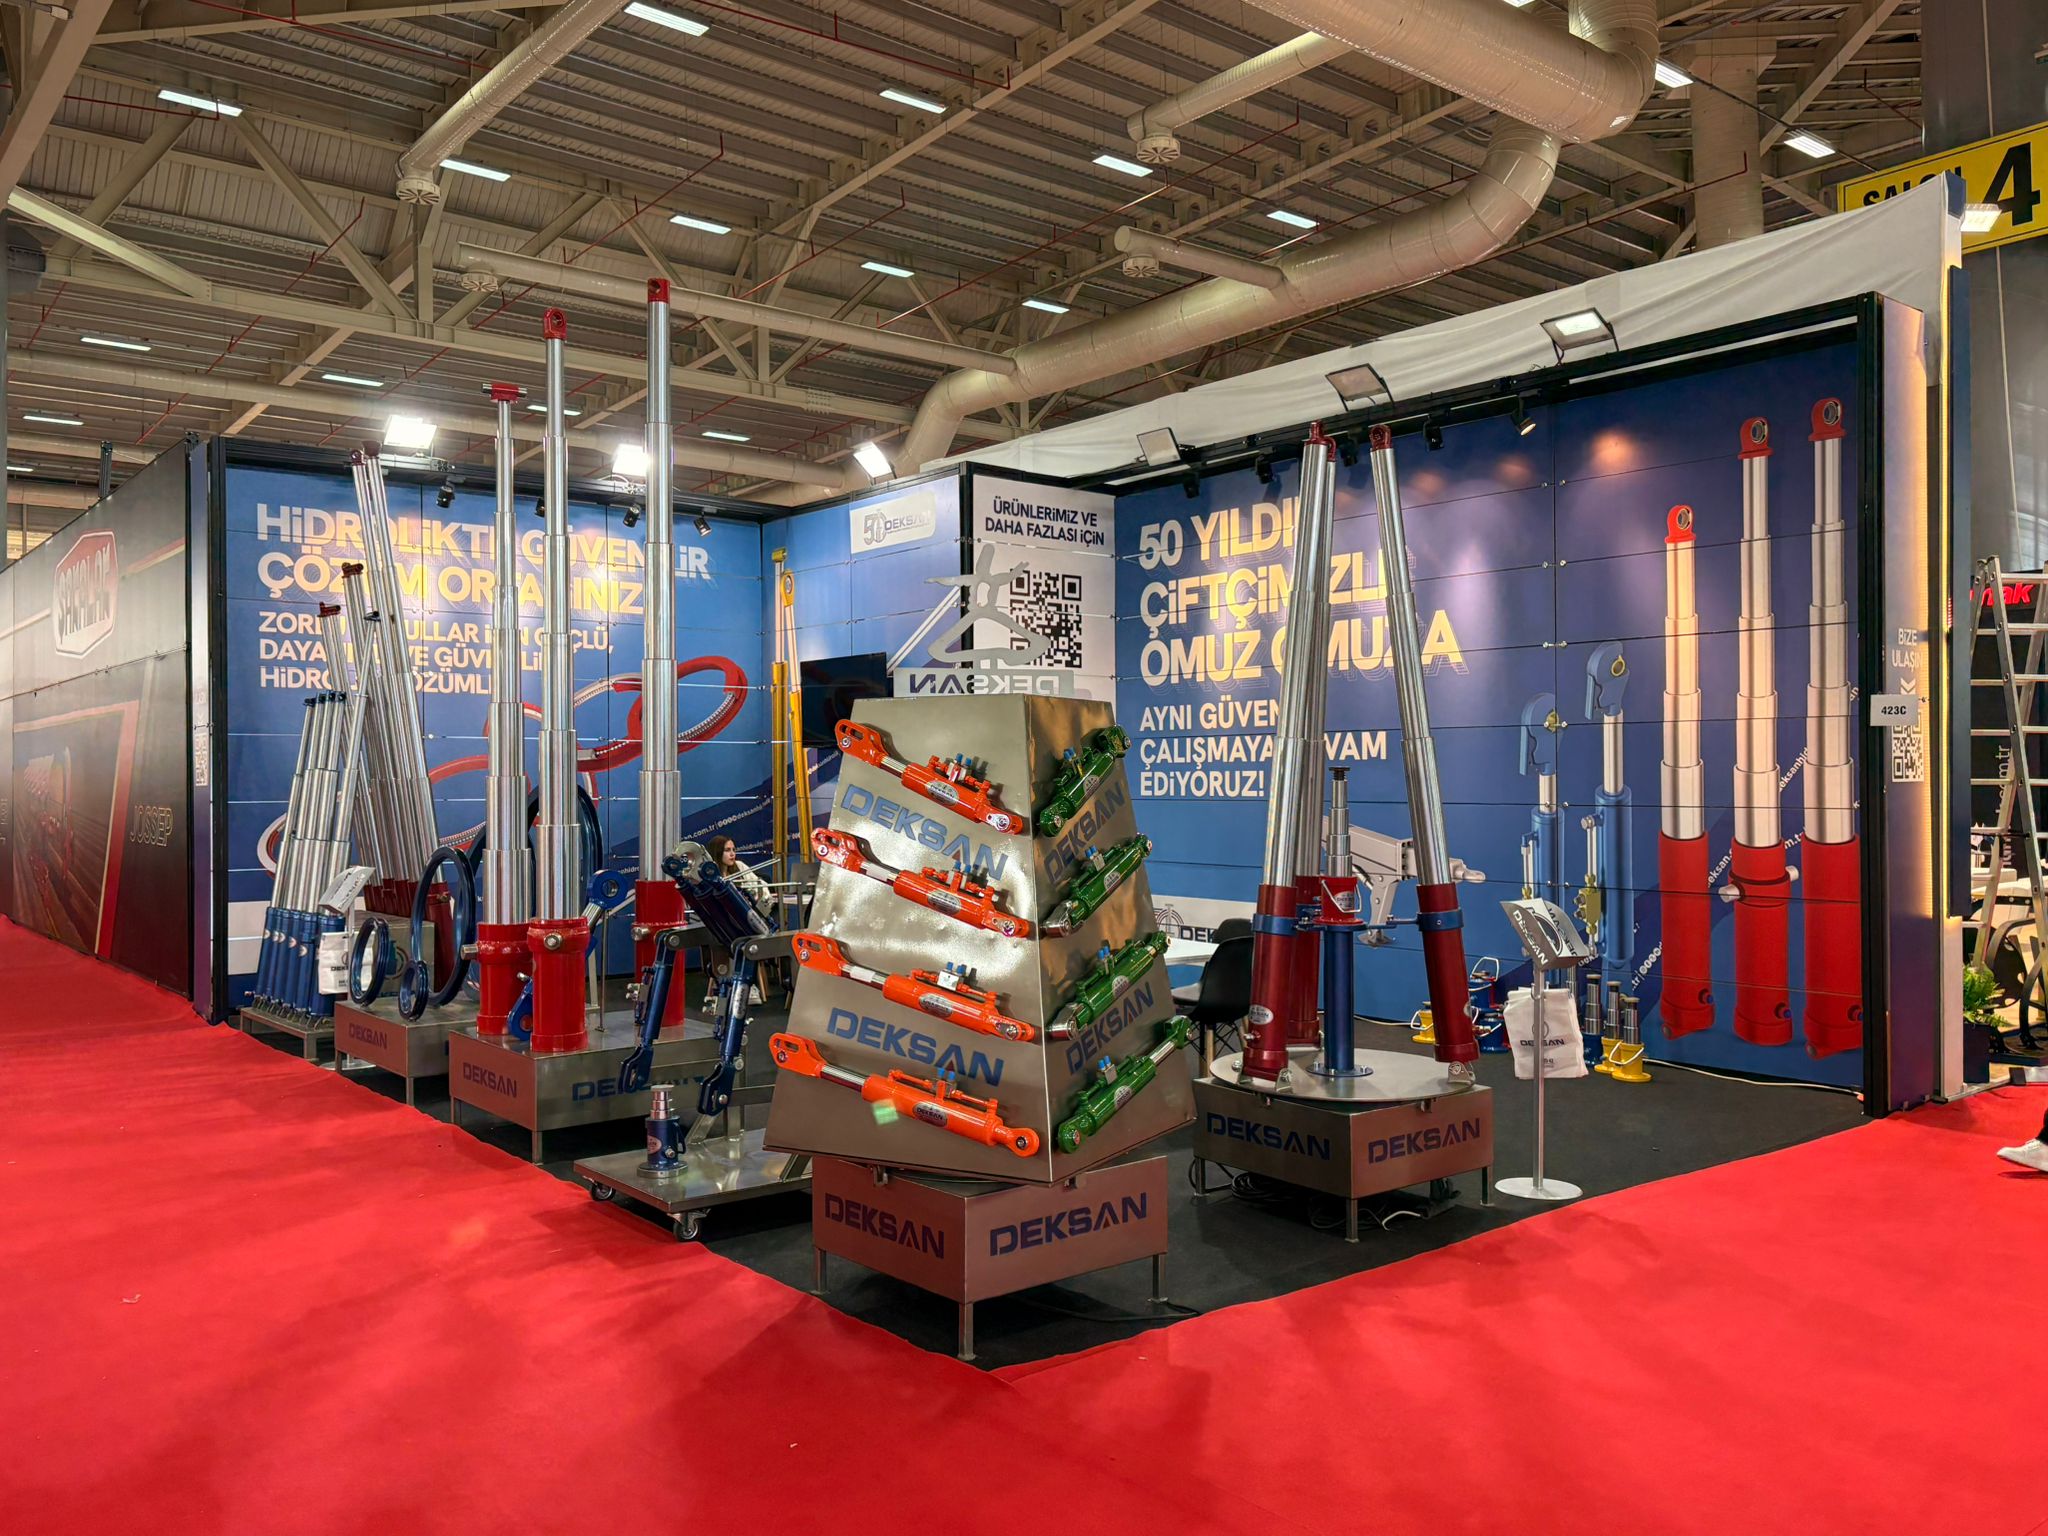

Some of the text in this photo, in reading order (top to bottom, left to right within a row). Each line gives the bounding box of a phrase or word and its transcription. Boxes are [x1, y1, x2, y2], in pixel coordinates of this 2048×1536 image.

[1983, 142, 2040, 226] 4
[985, 517, 1023, 536] DAHA
[1027, 523, 1077, 542] FAZLASI
[1081, 512, 1097, 527] VE
[1139, 496, 1299, 570] 50 YILDI
[1140, 630, 1261, 686] OMUZ
[1139, 705, 1192, 731] AYNI
[1881, 705, 1907, 715] 423C
[1140, 735, 1272, 770] ÇALIŞMAYA
[841, 784, 1008, 881] DEKSAN
[827, 1007, 1004, 1087] DEKSAN
[1066, 981, 1154, 1075] DEKSAN
[463, 1062, 517, 1098] DEKSAN
[1207, 1112, 1330, 1160] DEKSAN
[1368, 1117, 1480, 1164] DEKSAN
[825, 1192, 944, 1259] DEKSAN
[990, 1192, 1147, 1256] DEKSAN
